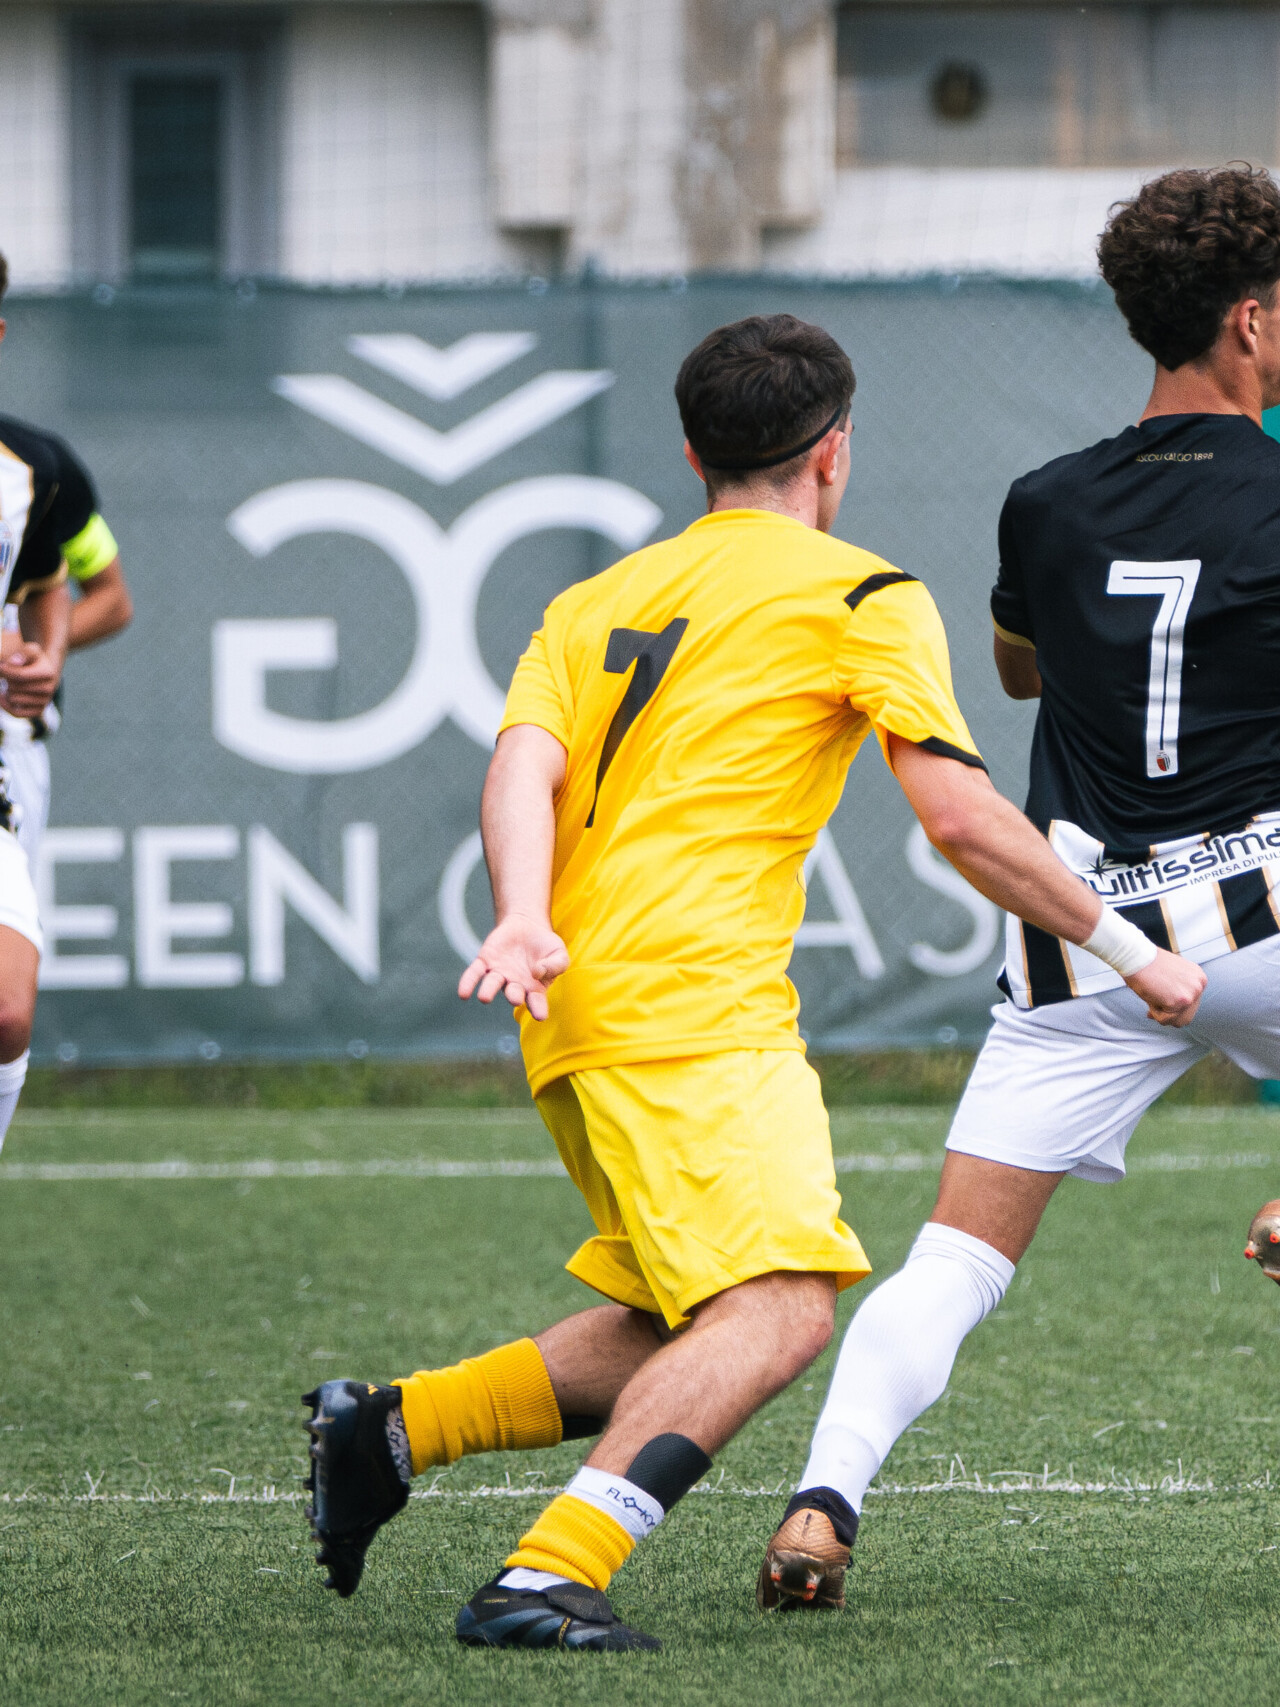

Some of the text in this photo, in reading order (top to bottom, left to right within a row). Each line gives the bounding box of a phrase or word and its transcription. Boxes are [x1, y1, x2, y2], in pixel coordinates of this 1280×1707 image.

[1193, 452, 1214, 461] 1898
[1107, 559, 1201, 778] 7
[1189, 863, 1241, 886] IMPRESA
[1242, 857, 1257, 868] DI
